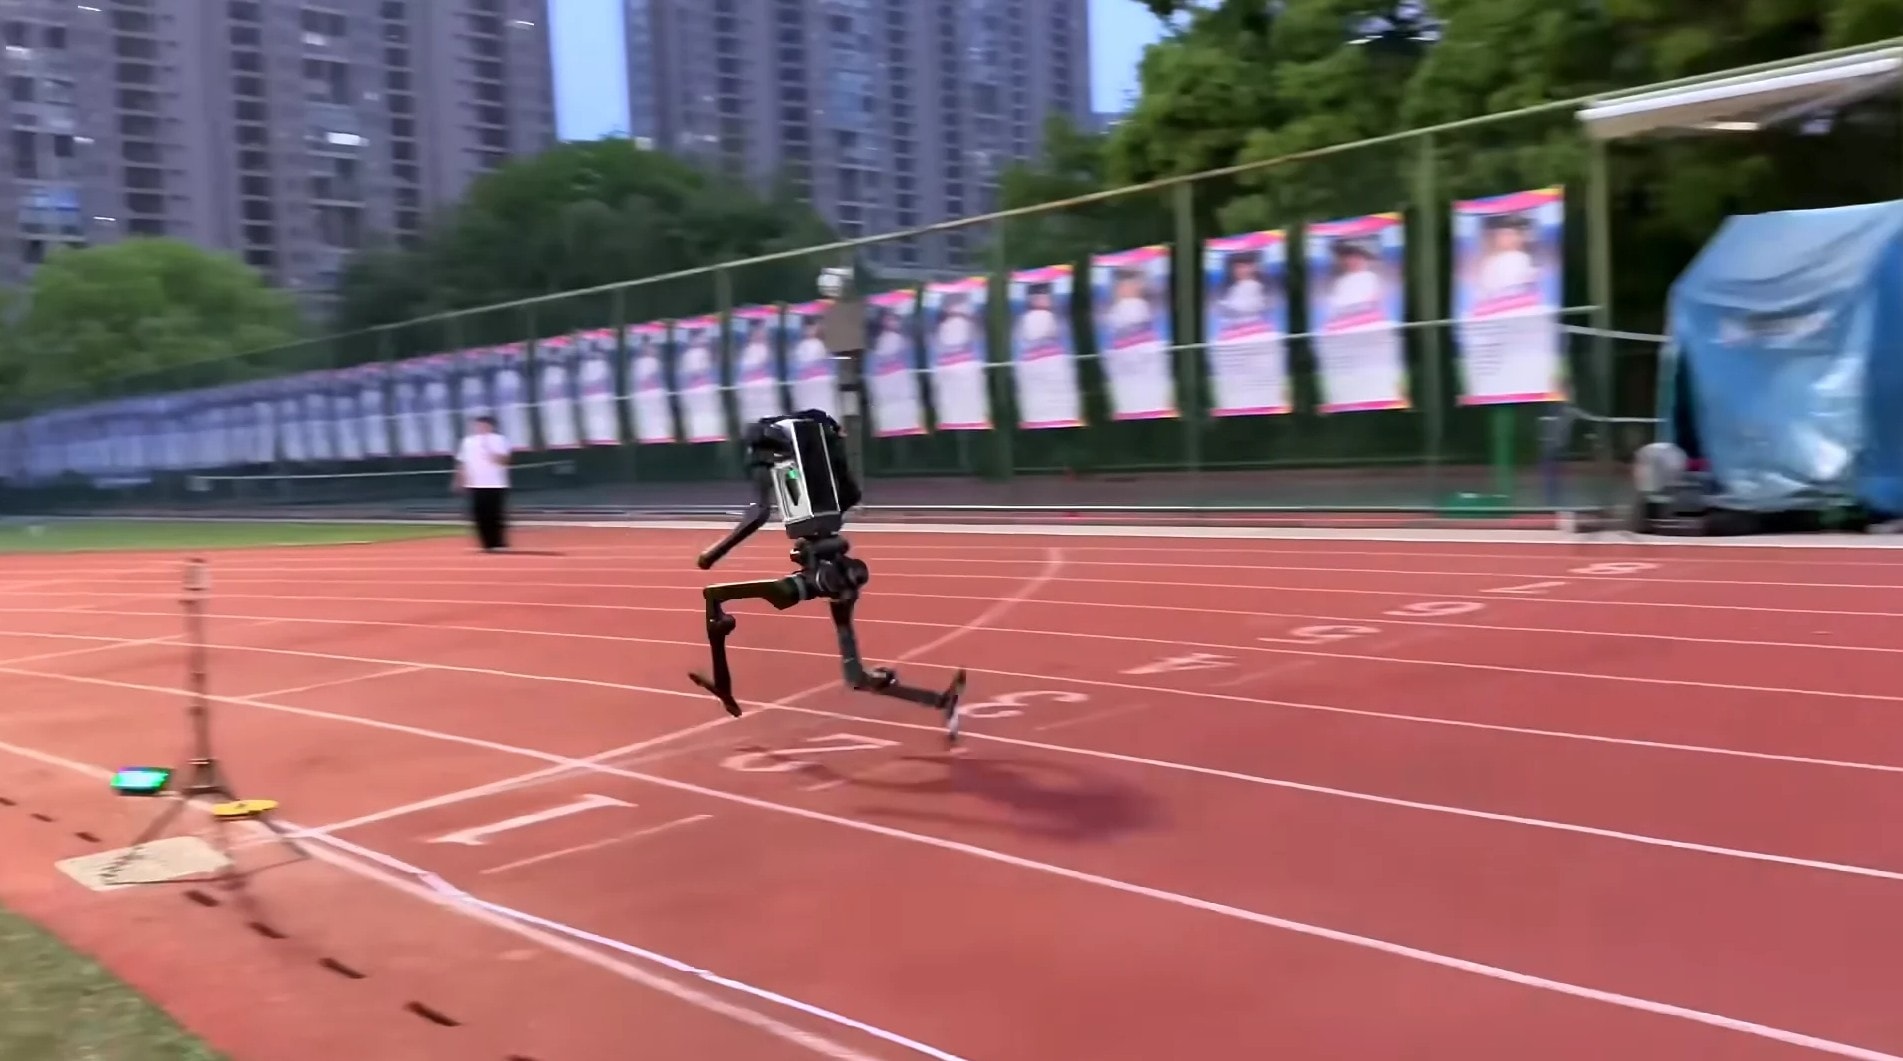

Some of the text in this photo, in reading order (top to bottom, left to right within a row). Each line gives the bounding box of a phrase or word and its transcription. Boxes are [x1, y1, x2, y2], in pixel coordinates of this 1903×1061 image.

[1567, 562, 1663, 574] 8
[1381, 601, 1486, 616] 6
[1256, 625, 1379, 644] 5
[1118, 653, 1240, 674] 4
[957, 690, 1089, 718] 3
[719, 733, 901, 772] 2
[423, 793, 639, 845] 1
